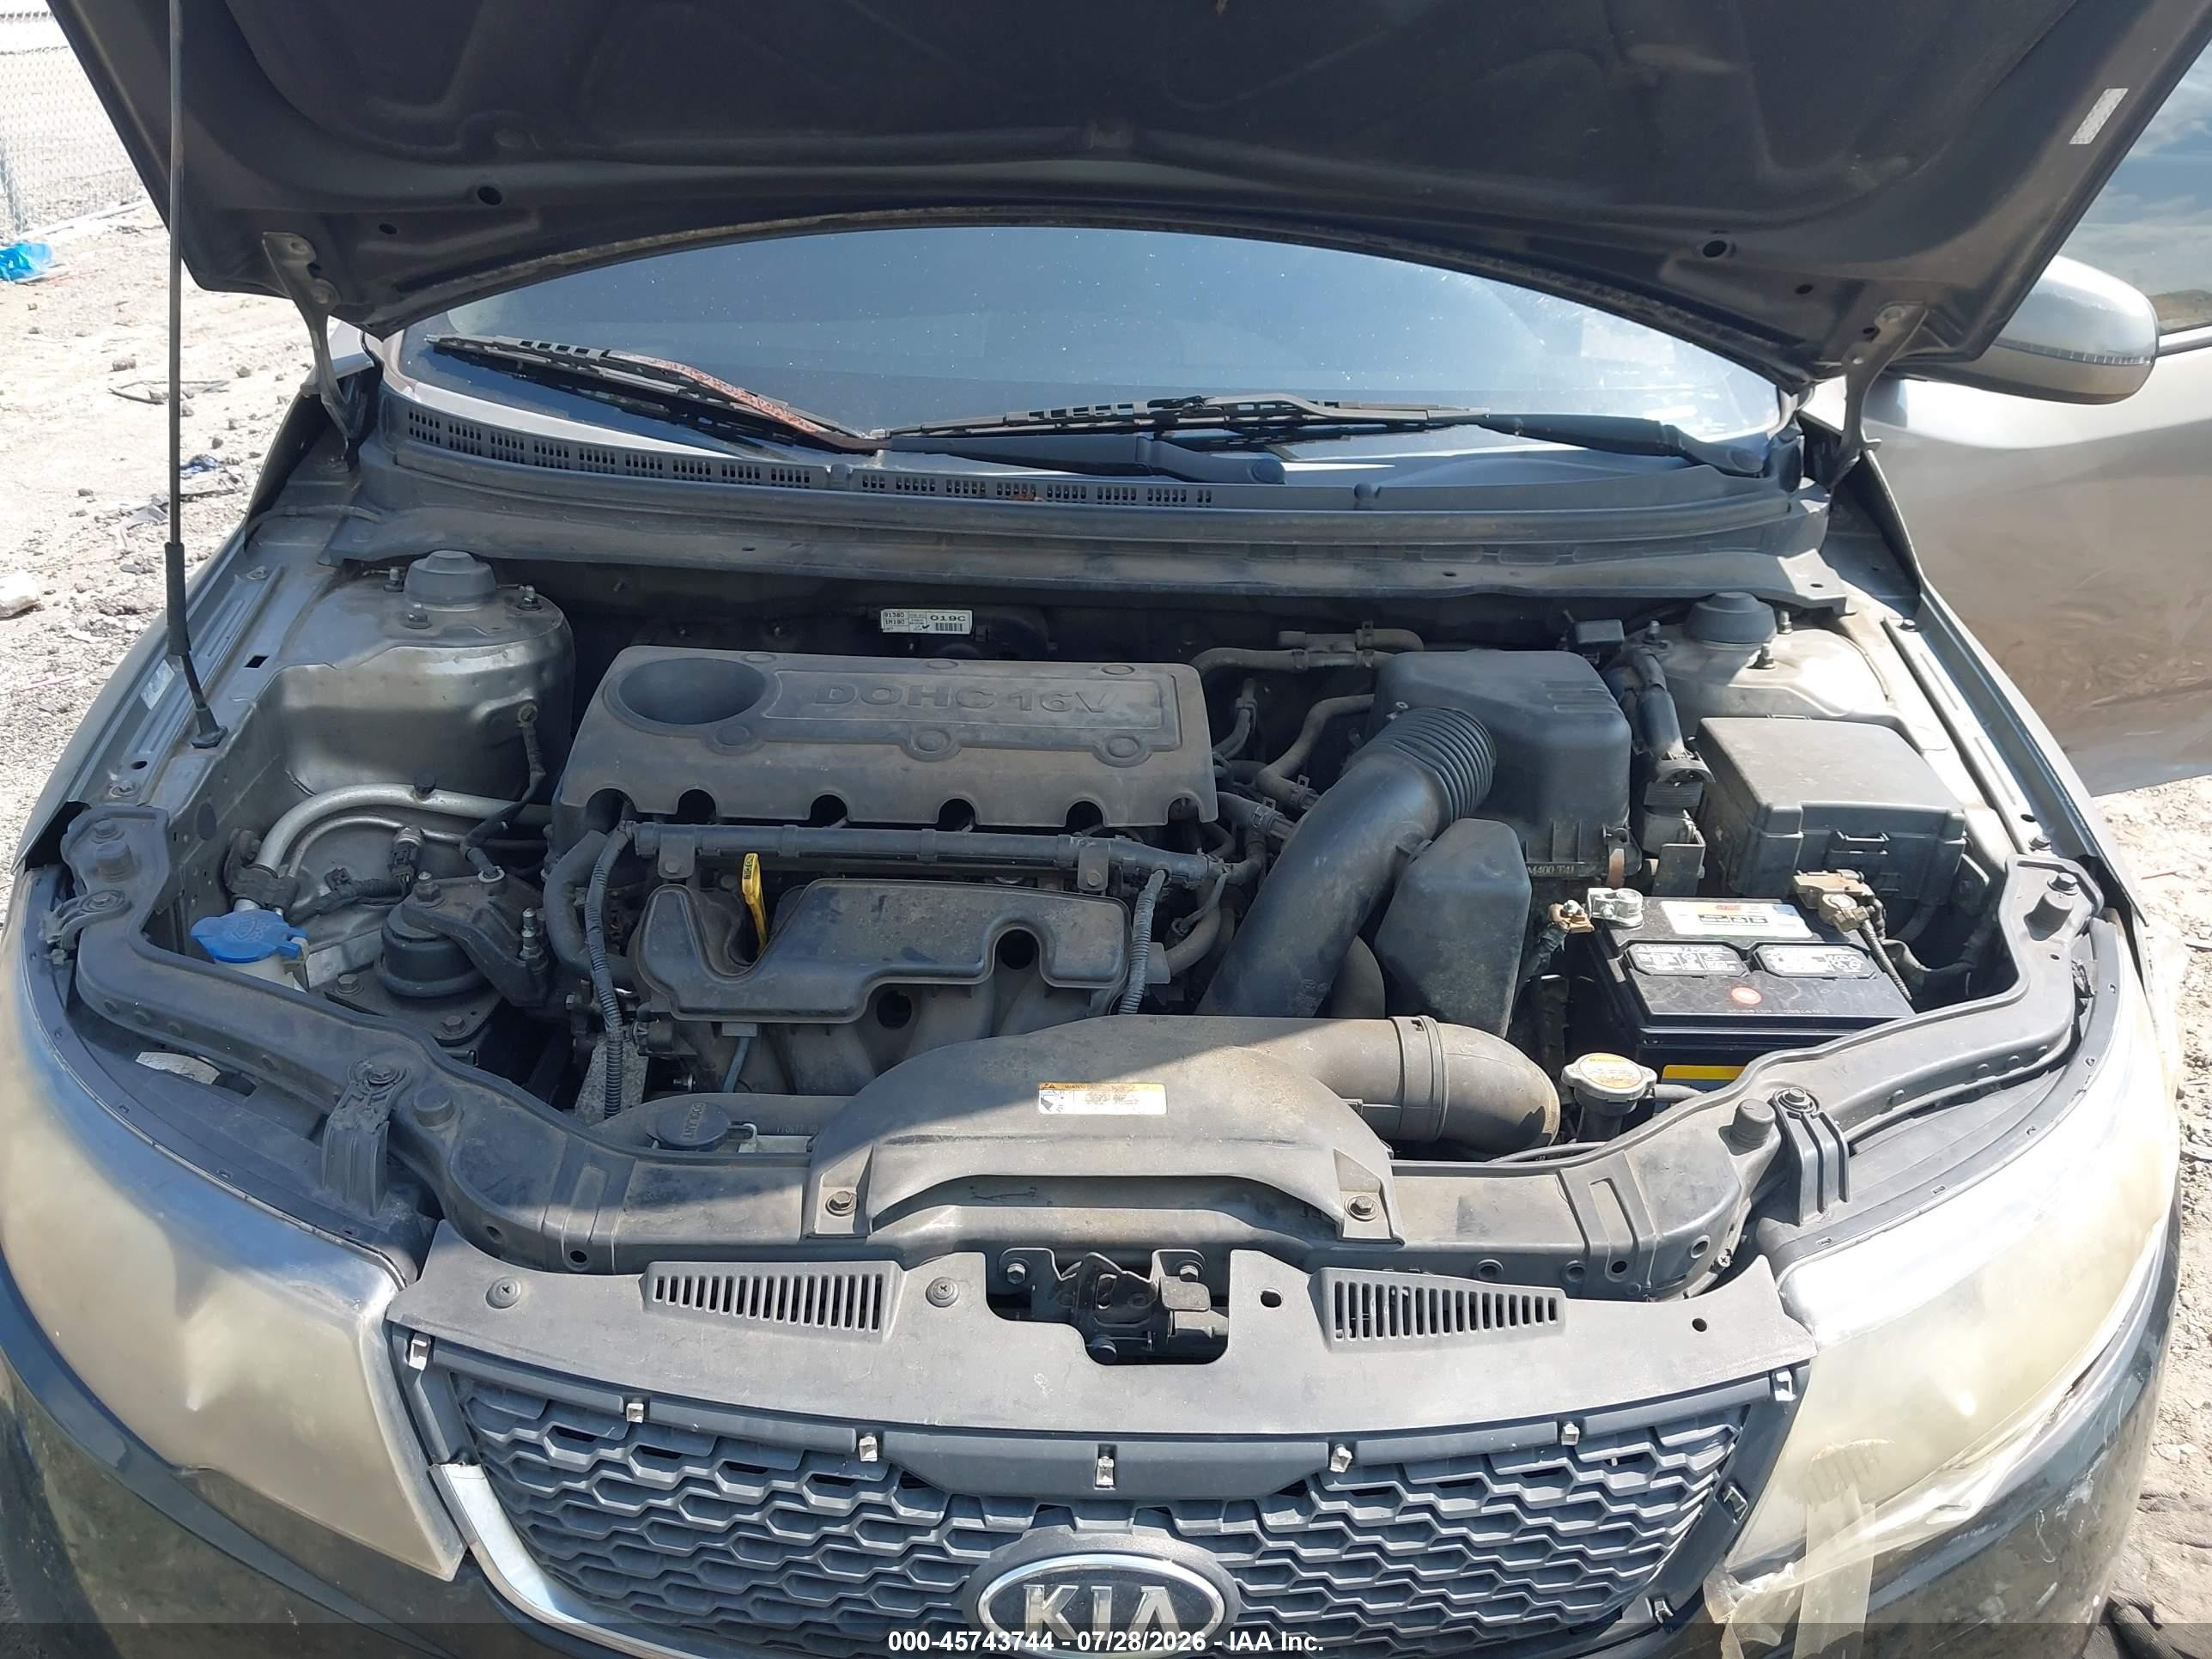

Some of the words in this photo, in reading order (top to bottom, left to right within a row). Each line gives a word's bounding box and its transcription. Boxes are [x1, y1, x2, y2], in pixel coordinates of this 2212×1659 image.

[813, 684, 995, 709] DOHC
[1008, 691, 1107, 714] 16V
[1023, 1583, 1182, 1641] KIA
